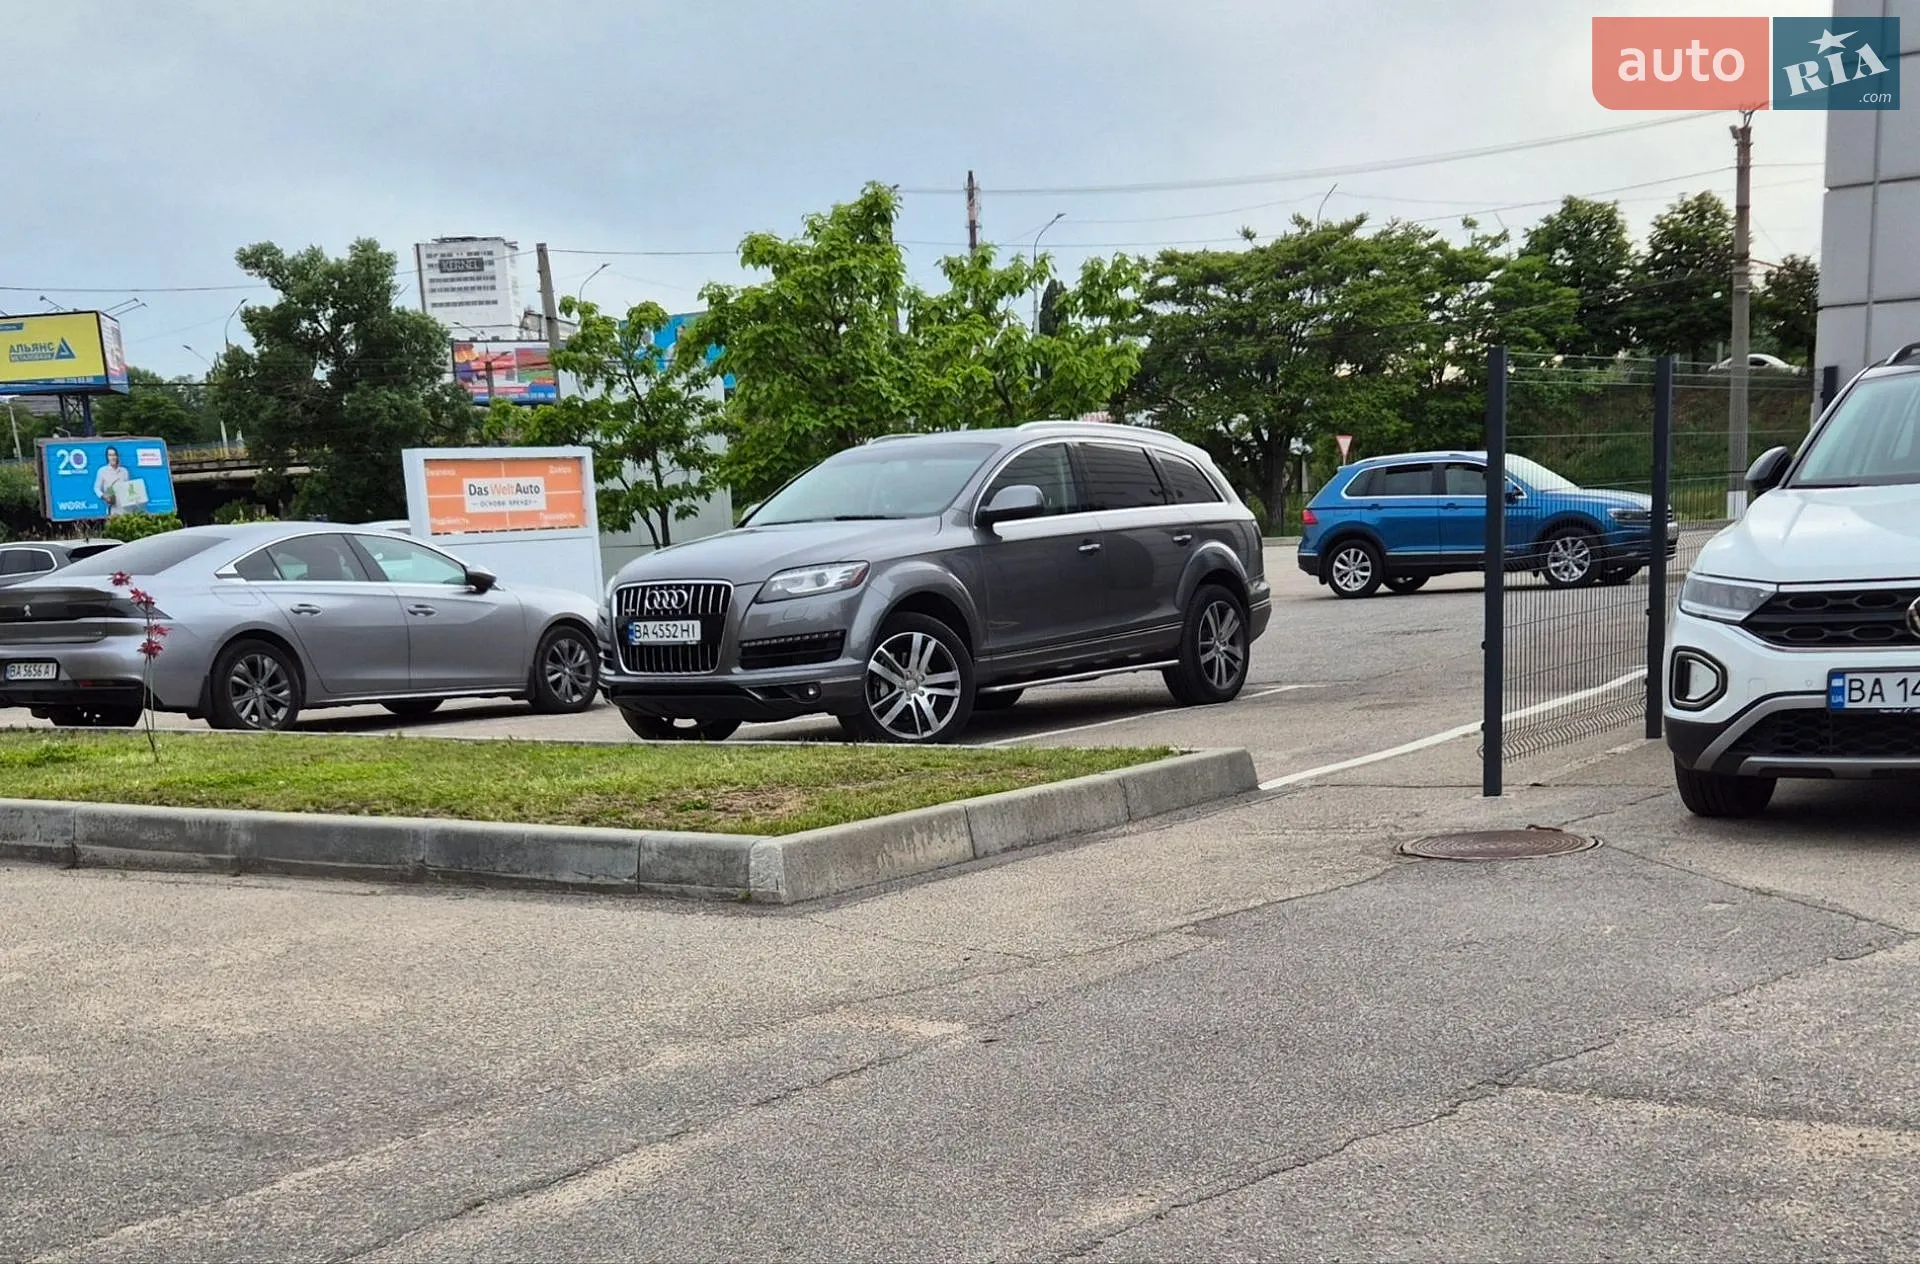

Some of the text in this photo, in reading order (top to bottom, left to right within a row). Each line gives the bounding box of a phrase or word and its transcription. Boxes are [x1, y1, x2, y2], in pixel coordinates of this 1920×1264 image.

[441, 259, 481, 270] KERNEL
[9, 342, 54, 353] АЛЬЯНС
[56, 448, 88, 470] 20
[468, 483, 489, 496] Das
[634, 623, 695, 639] BA 4552 HI
[10, 664, 21, 677] BA
[1848, 678, 1886, 703] BA
